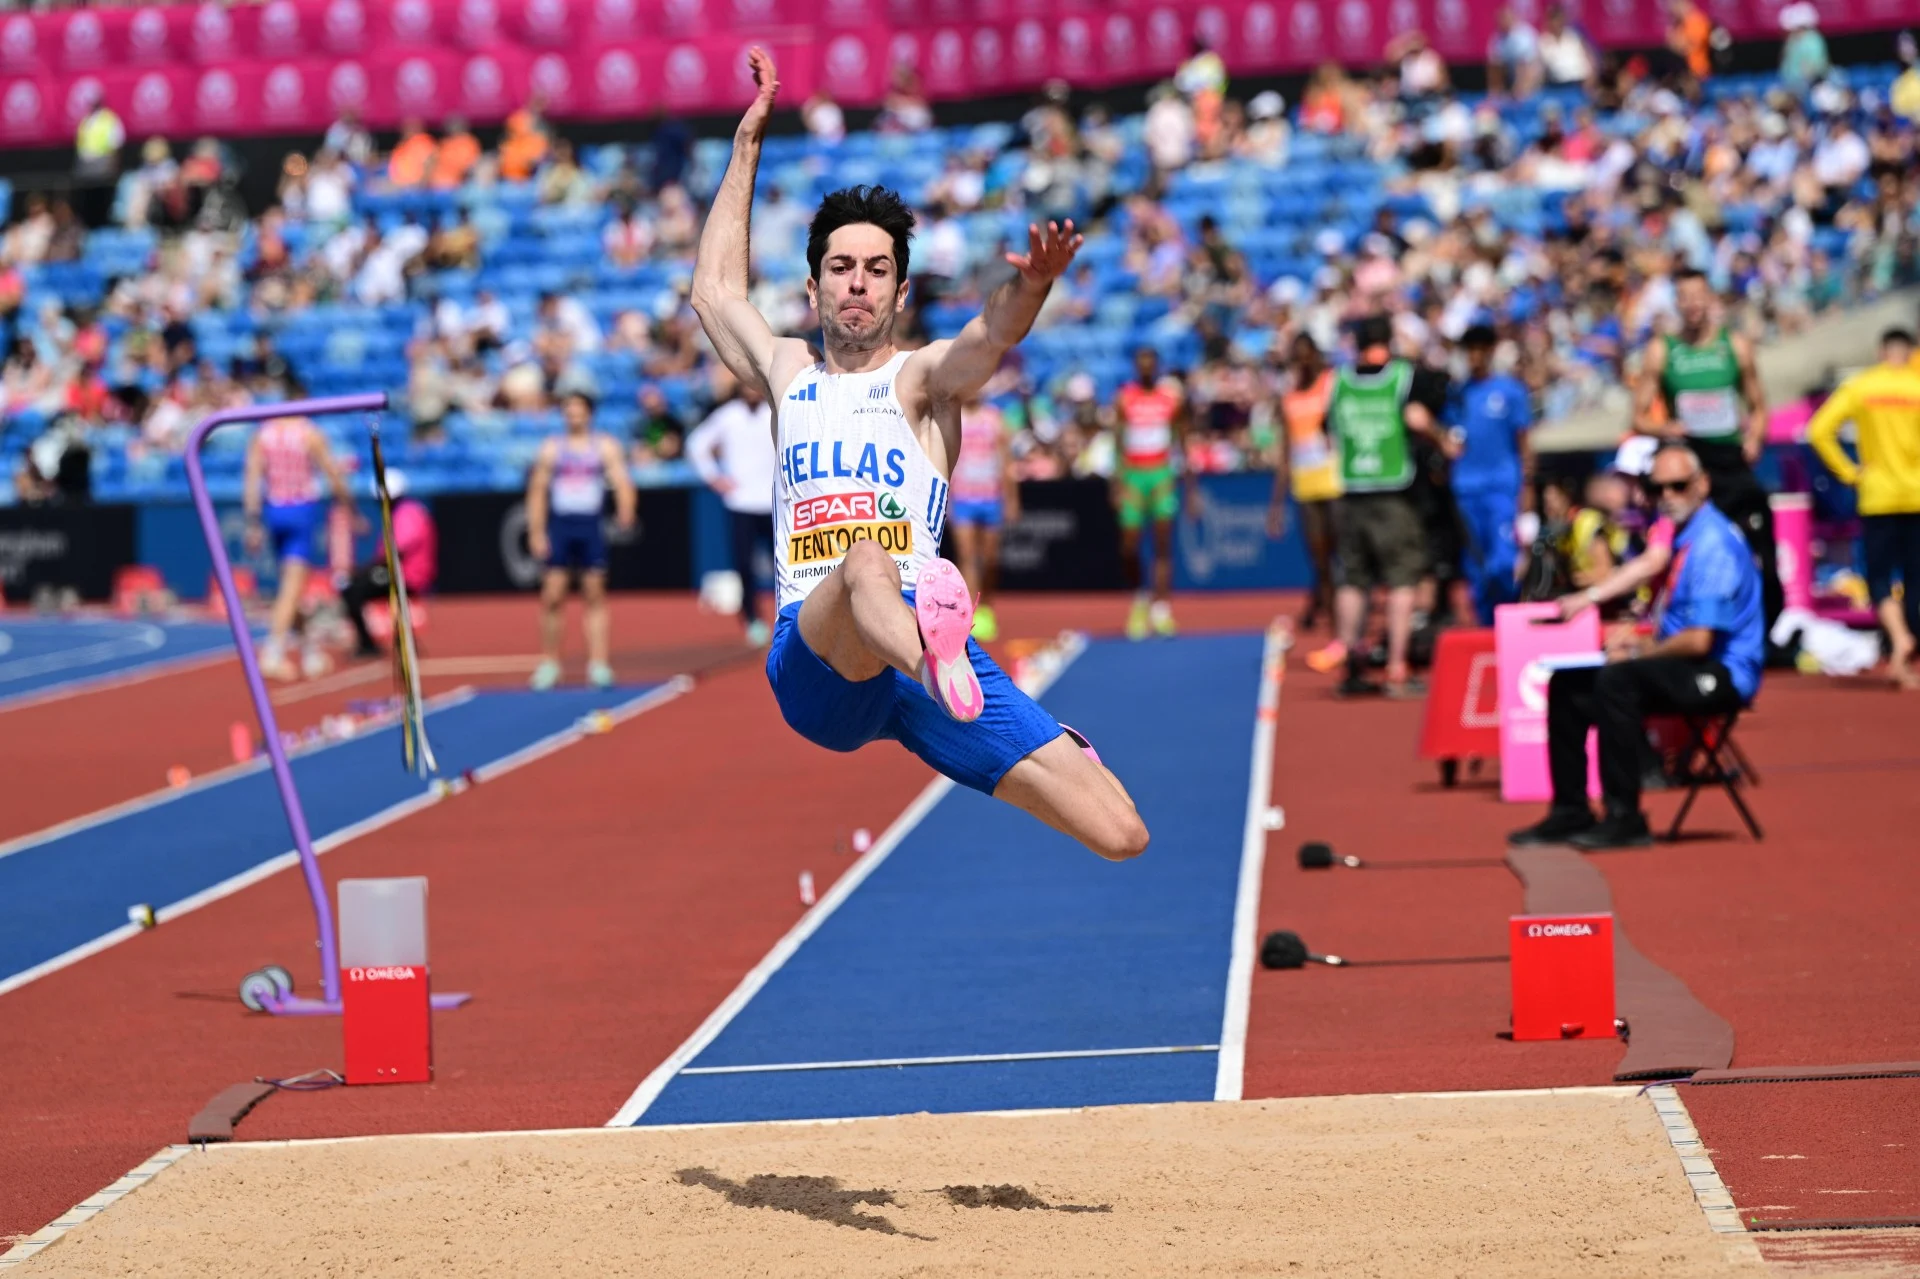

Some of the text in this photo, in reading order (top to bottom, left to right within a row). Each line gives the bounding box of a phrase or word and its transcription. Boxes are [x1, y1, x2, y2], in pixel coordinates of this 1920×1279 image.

[853, 407, 897, 415] AEGEAN
[782, 441, 906, 488] HELLAS
[796, 495, 873, 526] SPAR
[793, 563, 842, 579] BIRMIN
[1543, 922, 1593, 937] OMEGA
[366, 966, 416, 981] OMEGA
